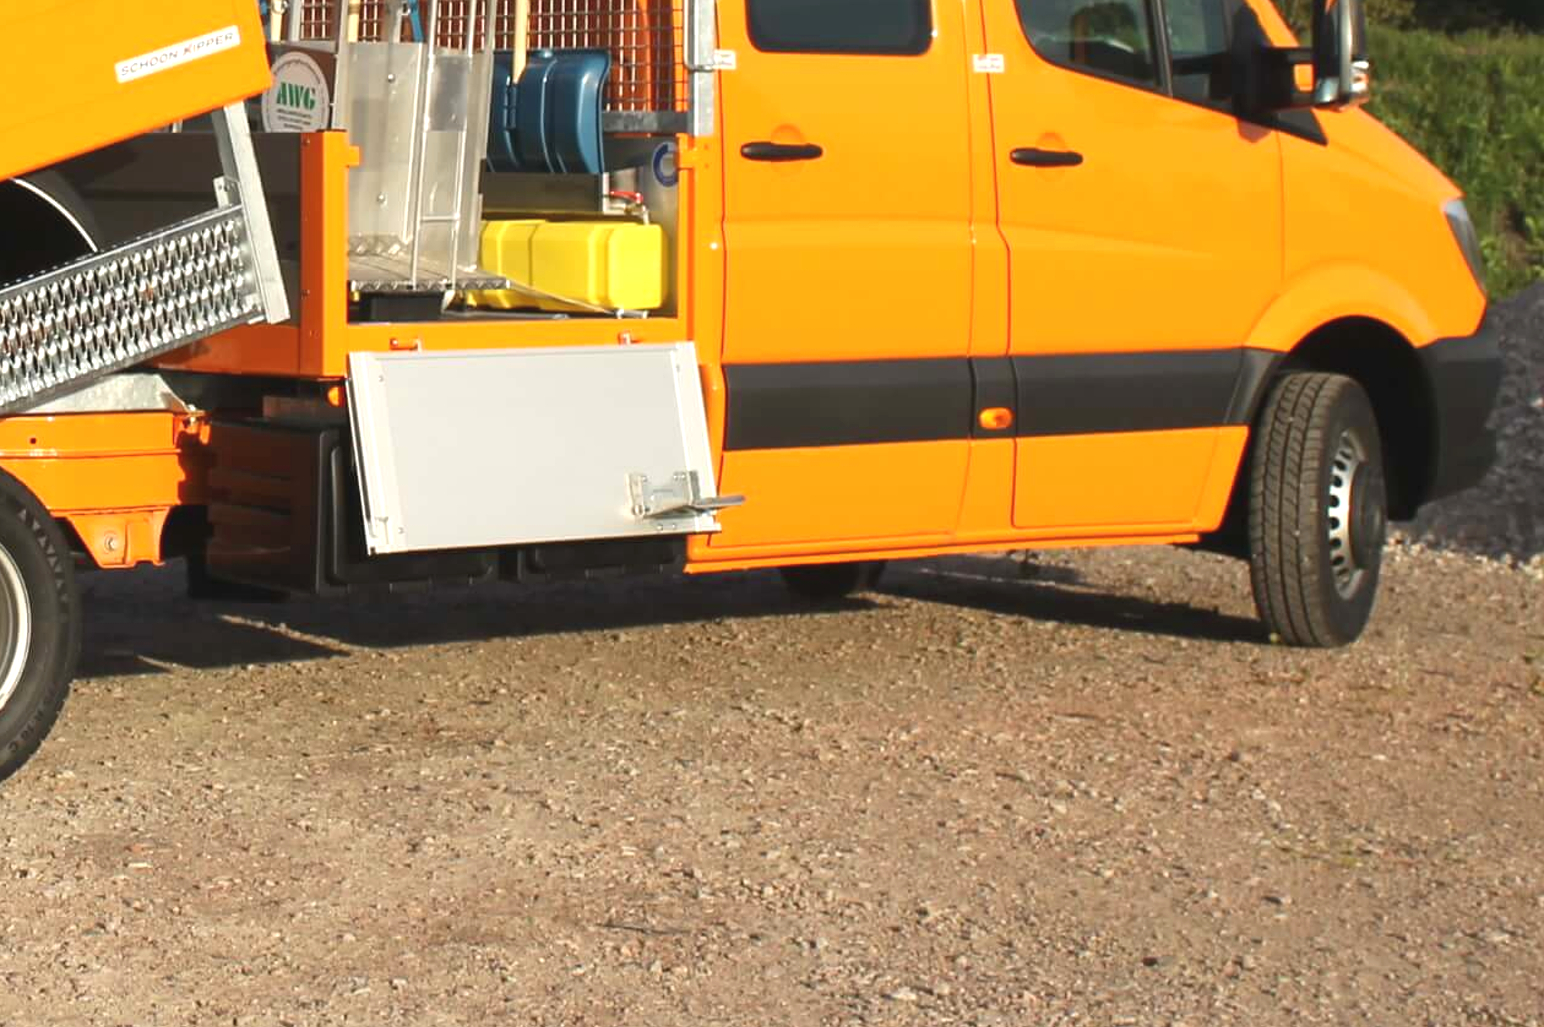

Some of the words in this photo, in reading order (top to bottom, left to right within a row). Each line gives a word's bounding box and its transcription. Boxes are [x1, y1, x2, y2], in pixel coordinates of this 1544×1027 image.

[121, 50, 179, 76] SCHOON
[183, 32, 234, 56] KIPPER
[276, 80, 316, 111] AWG
